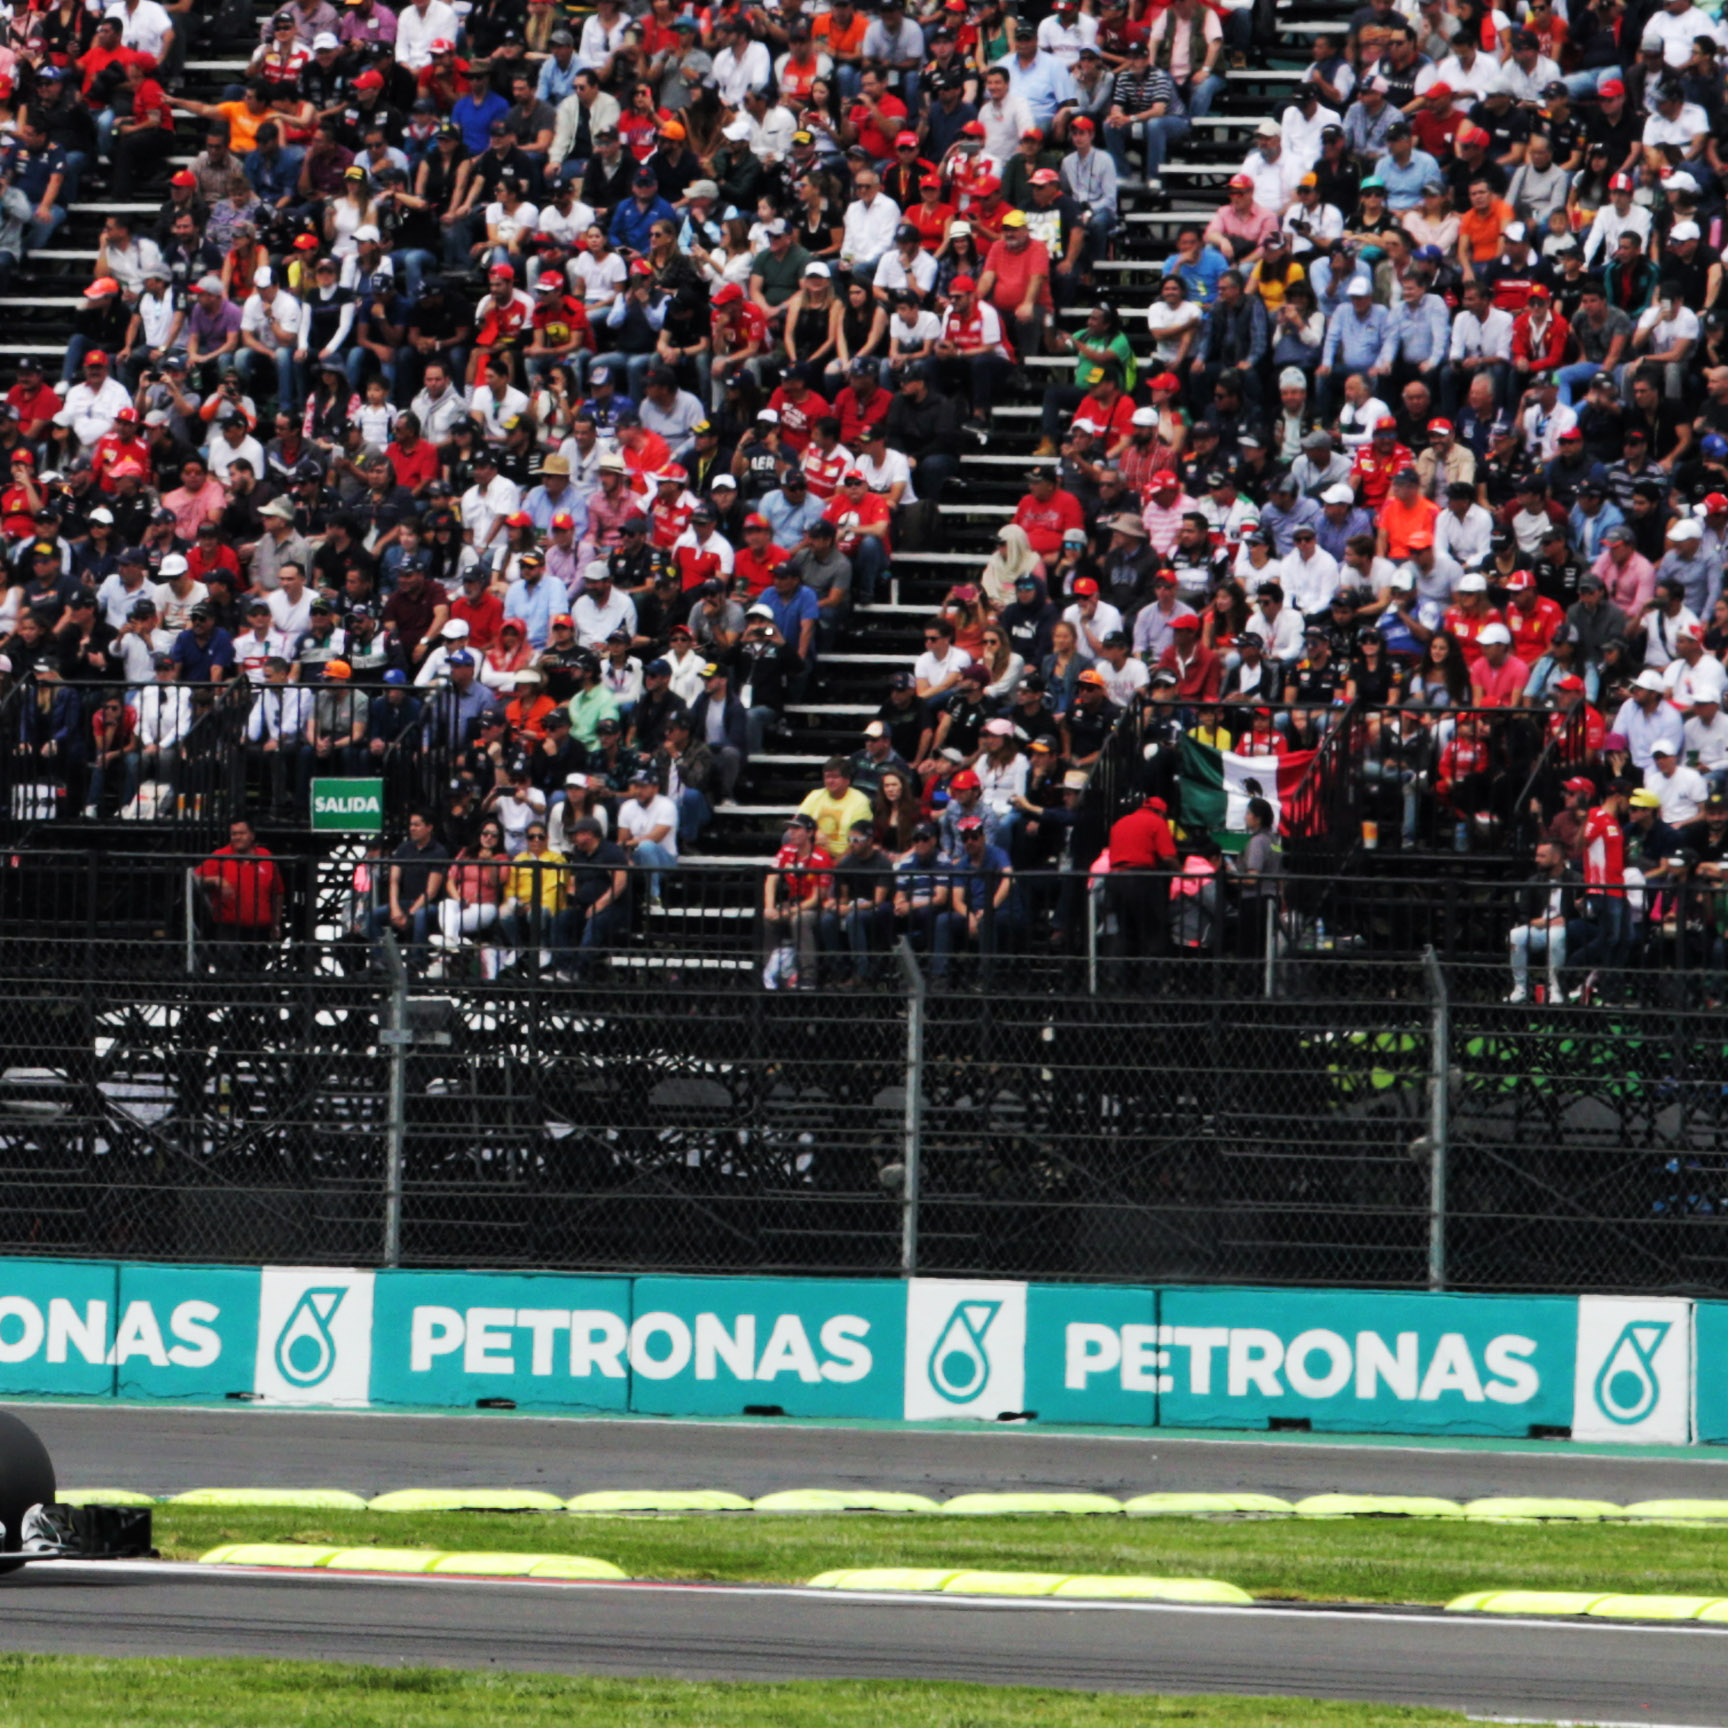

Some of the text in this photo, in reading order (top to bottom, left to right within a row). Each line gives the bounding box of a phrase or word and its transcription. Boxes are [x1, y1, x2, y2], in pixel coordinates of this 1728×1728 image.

[314, 796, 380, 813] SALIDA
[410, 1305, 872, 1383] PETRONAS
[1065, 1322, 1539, 1404] PETRONAS
